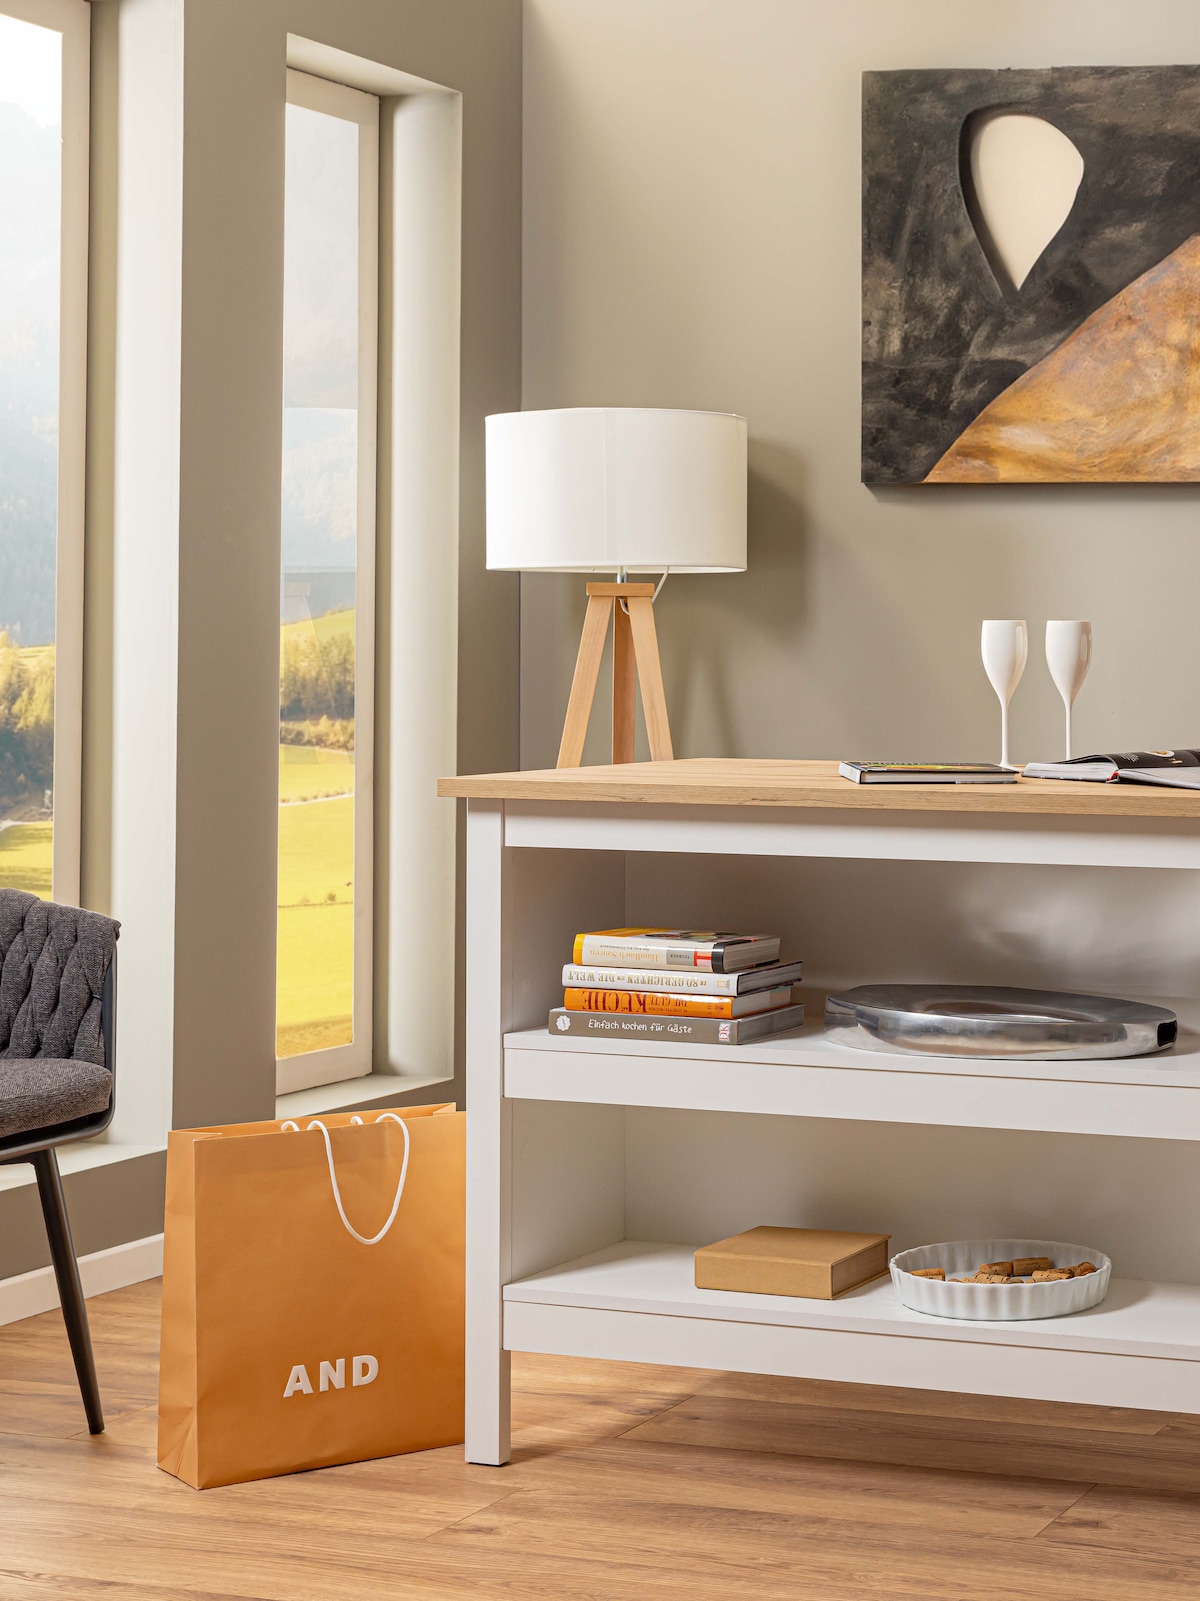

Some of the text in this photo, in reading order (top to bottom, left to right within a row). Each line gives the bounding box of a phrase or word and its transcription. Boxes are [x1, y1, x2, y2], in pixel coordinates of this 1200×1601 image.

[590, 949, 659, 962] Handbuch Saucen
[568, 969, 595, 982] WELT
[599, 971, 615, 982] DIE
[627, 972, 684, 986] GERICHTEN
[582, 991, 647, 1013] KÜCHE
[588, 1019, 693, 1034] Einfach kochen für Gäste
[720, 1024, 730, 1041] DK
[283, 1354, 379, 1398] AND
